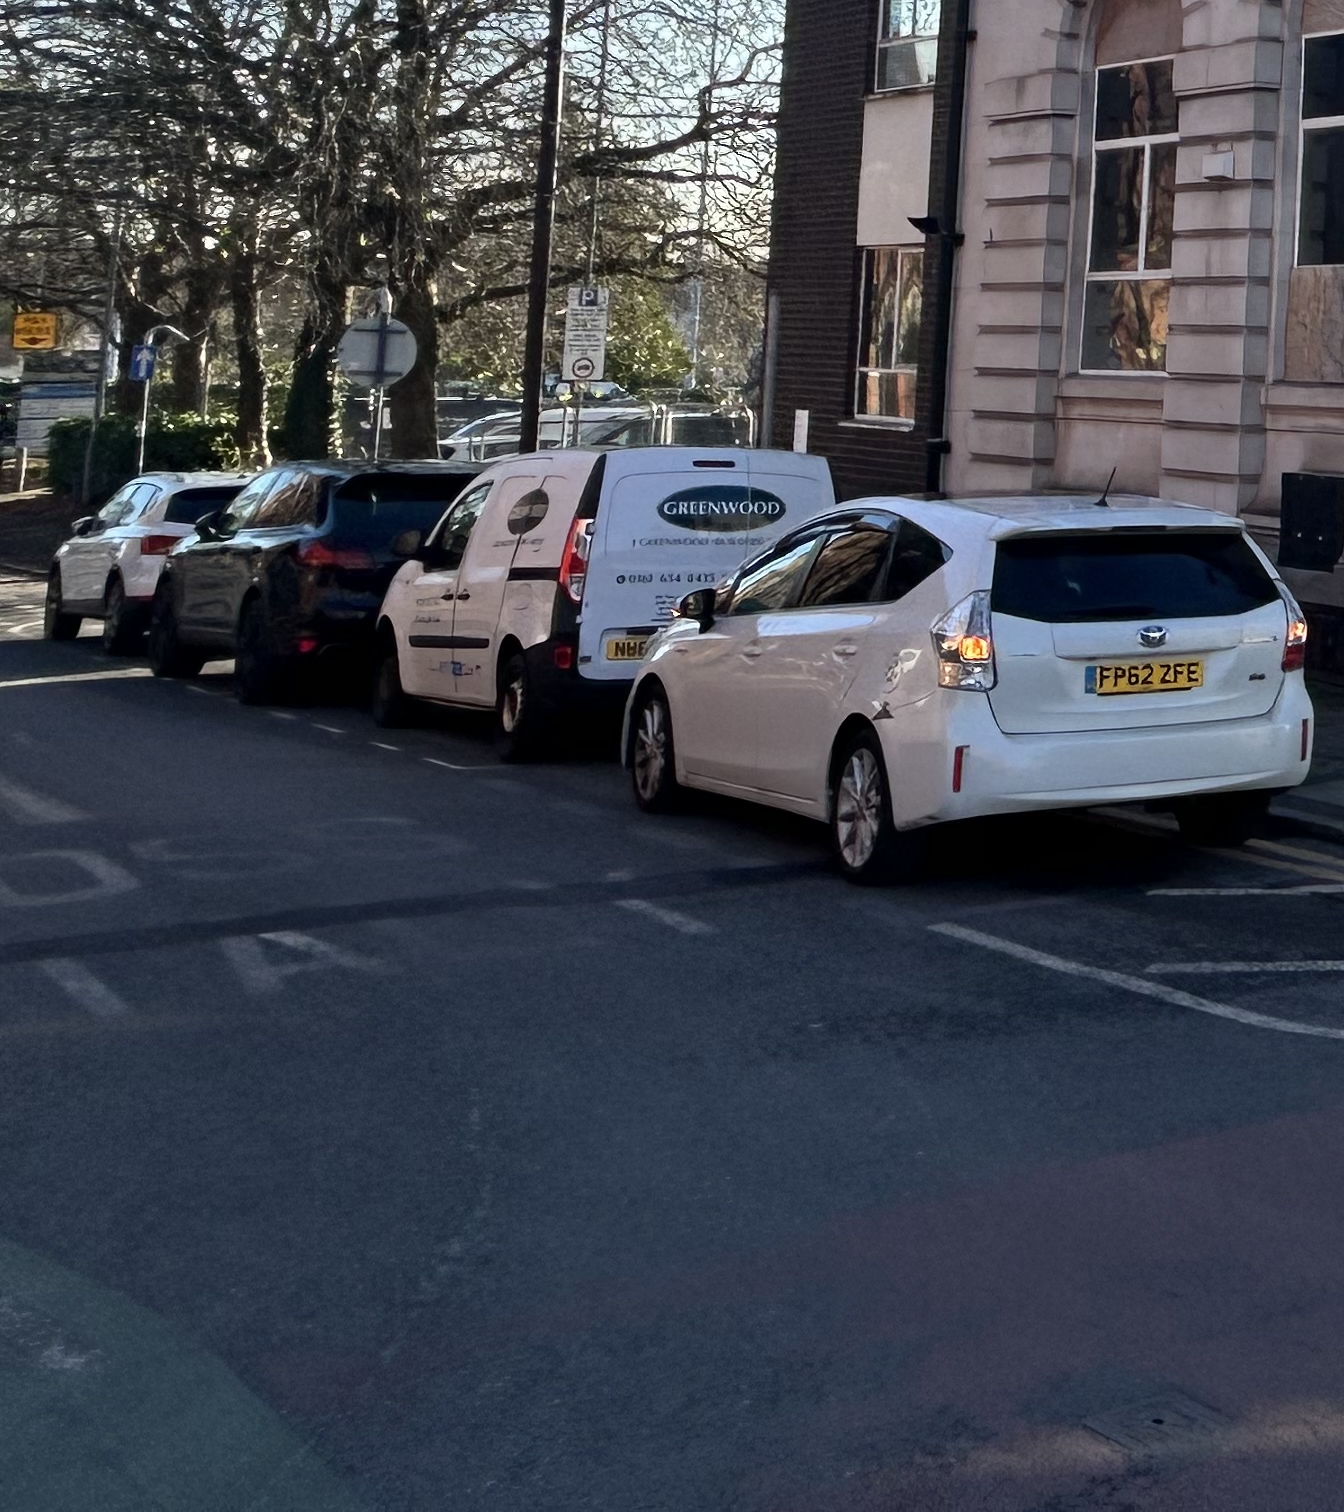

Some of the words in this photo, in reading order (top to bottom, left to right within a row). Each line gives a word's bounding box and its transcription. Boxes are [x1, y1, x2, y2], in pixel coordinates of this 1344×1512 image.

[663, 501, 781, 516] GREENWOOD
[1098, 663, 1154, 688] FP62
[1159, 661, 1200, 684] ZFE
